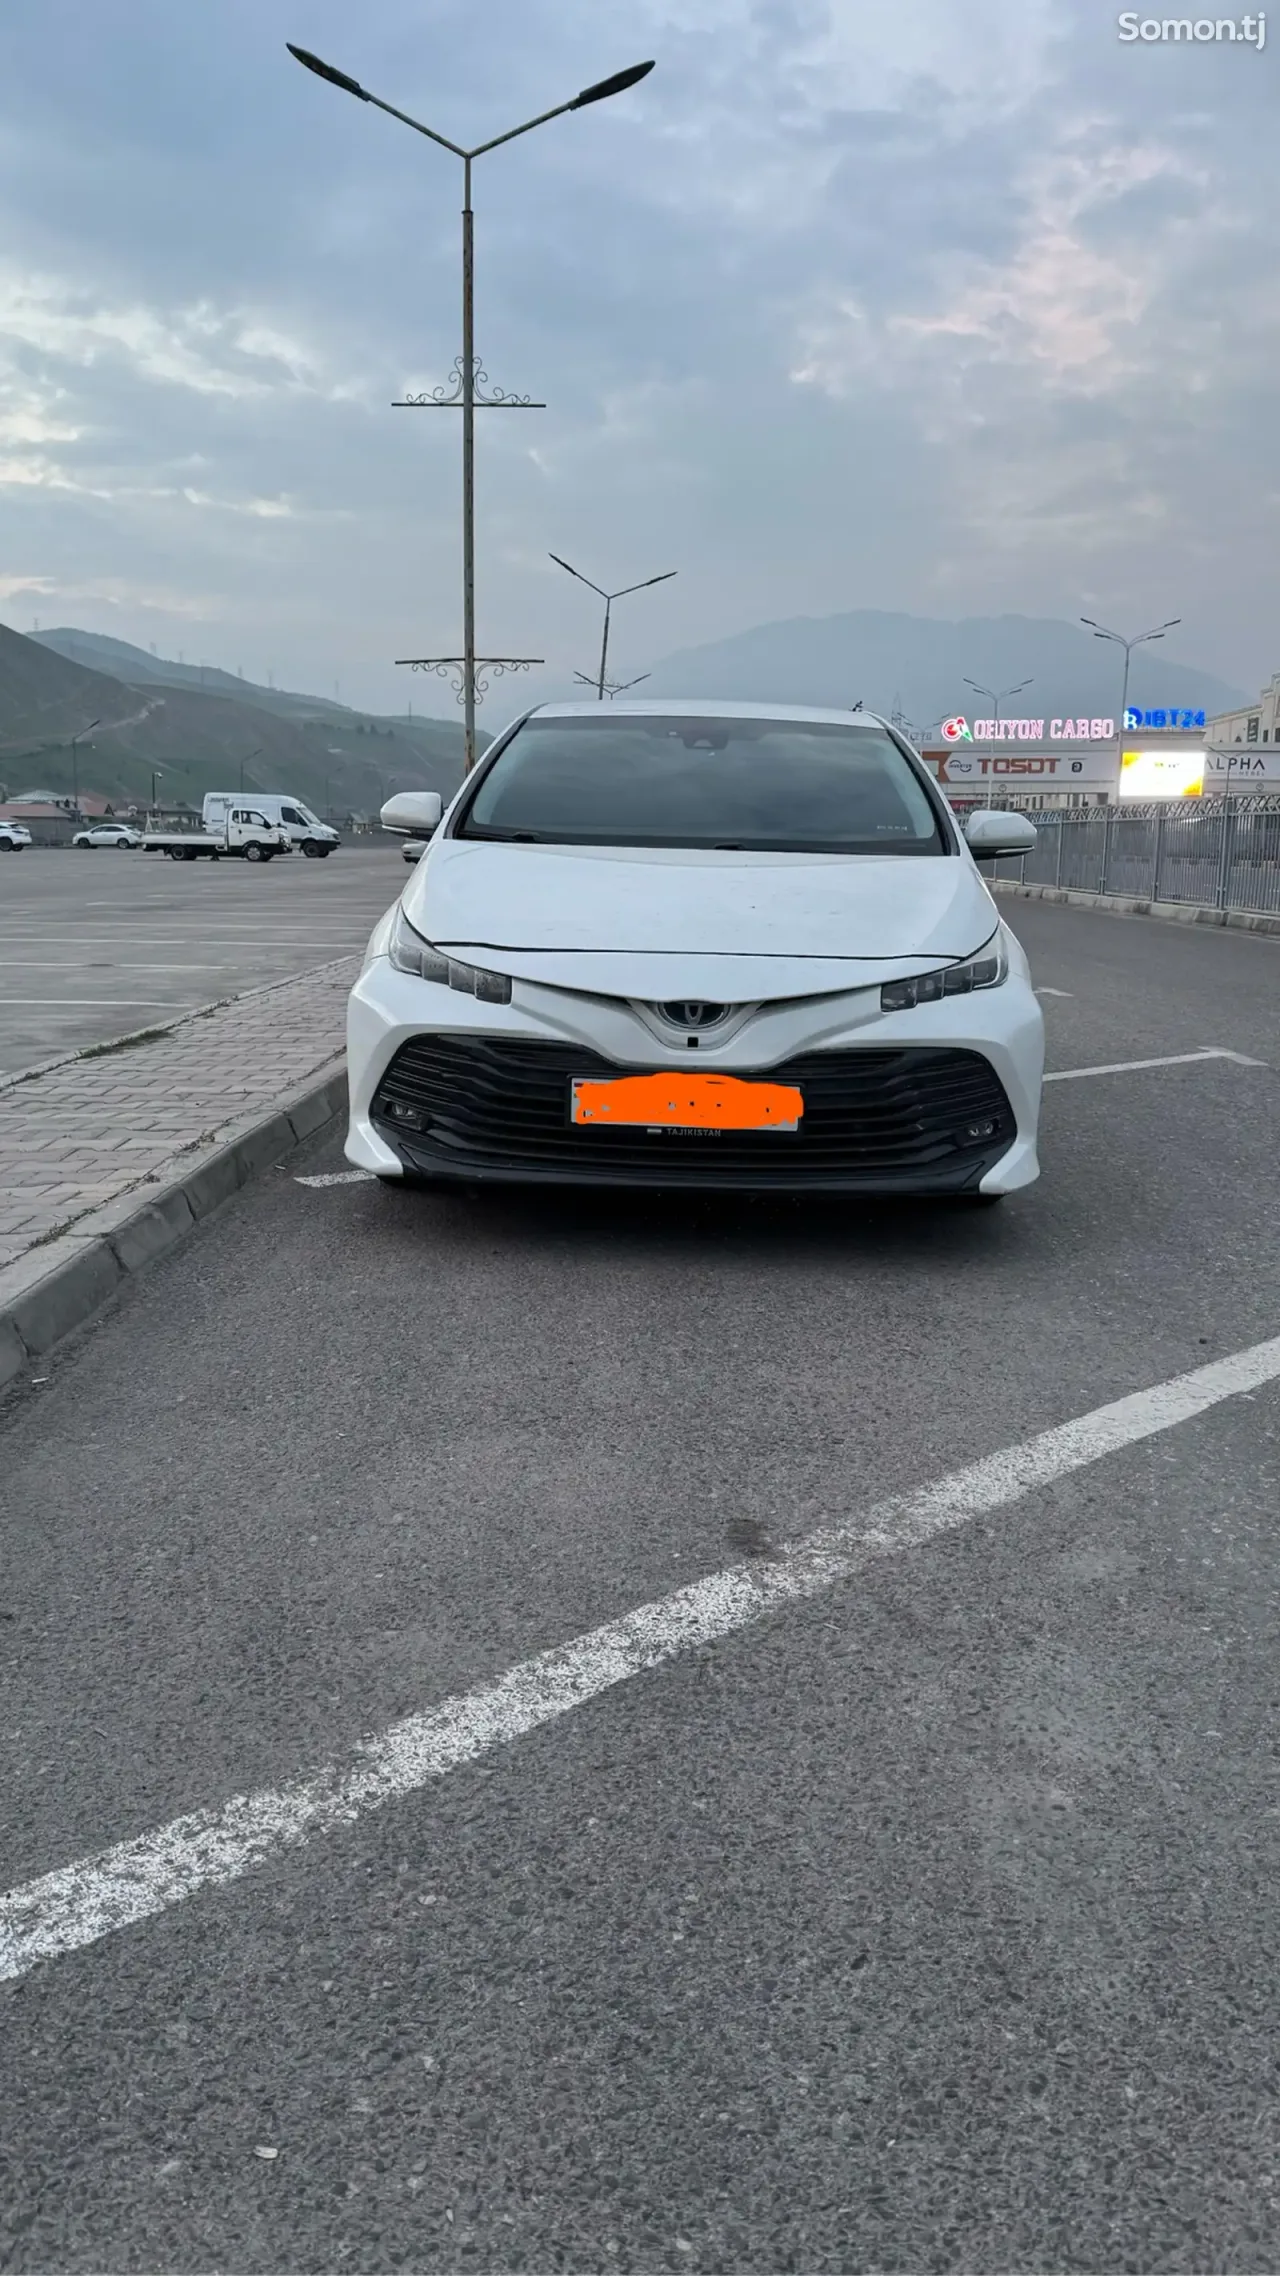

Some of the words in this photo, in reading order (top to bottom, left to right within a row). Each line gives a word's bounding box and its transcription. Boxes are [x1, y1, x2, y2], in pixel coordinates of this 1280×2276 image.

[1145, 708, 1206, 729] IBT24
[1050, 718, 1115, 740] CARGO
[977, 757, 1062, 775] TOSOT
[666, 1127, 722, 1138] TAJIKISTAN
